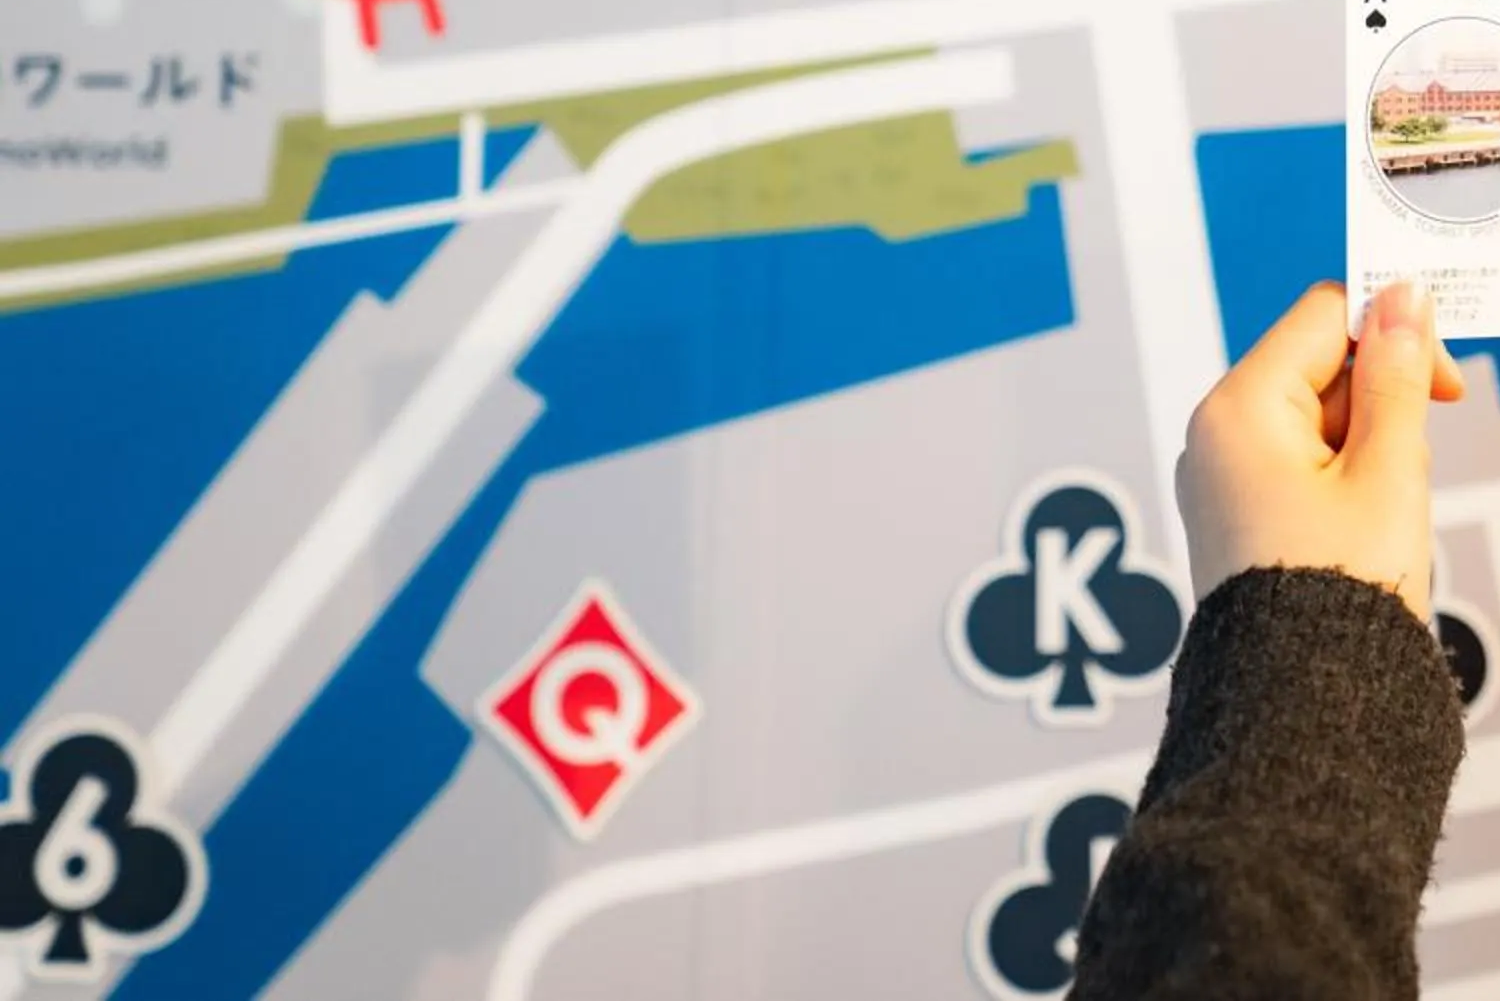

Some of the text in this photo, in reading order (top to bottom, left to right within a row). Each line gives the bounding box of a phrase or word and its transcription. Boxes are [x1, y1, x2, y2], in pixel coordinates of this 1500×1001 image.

[12, 51, 262, 109] ワールド
[1035, 527, 1123, 655] K
[530, 641, 648, 771] Q
[34, 777, 117, 910] 6
